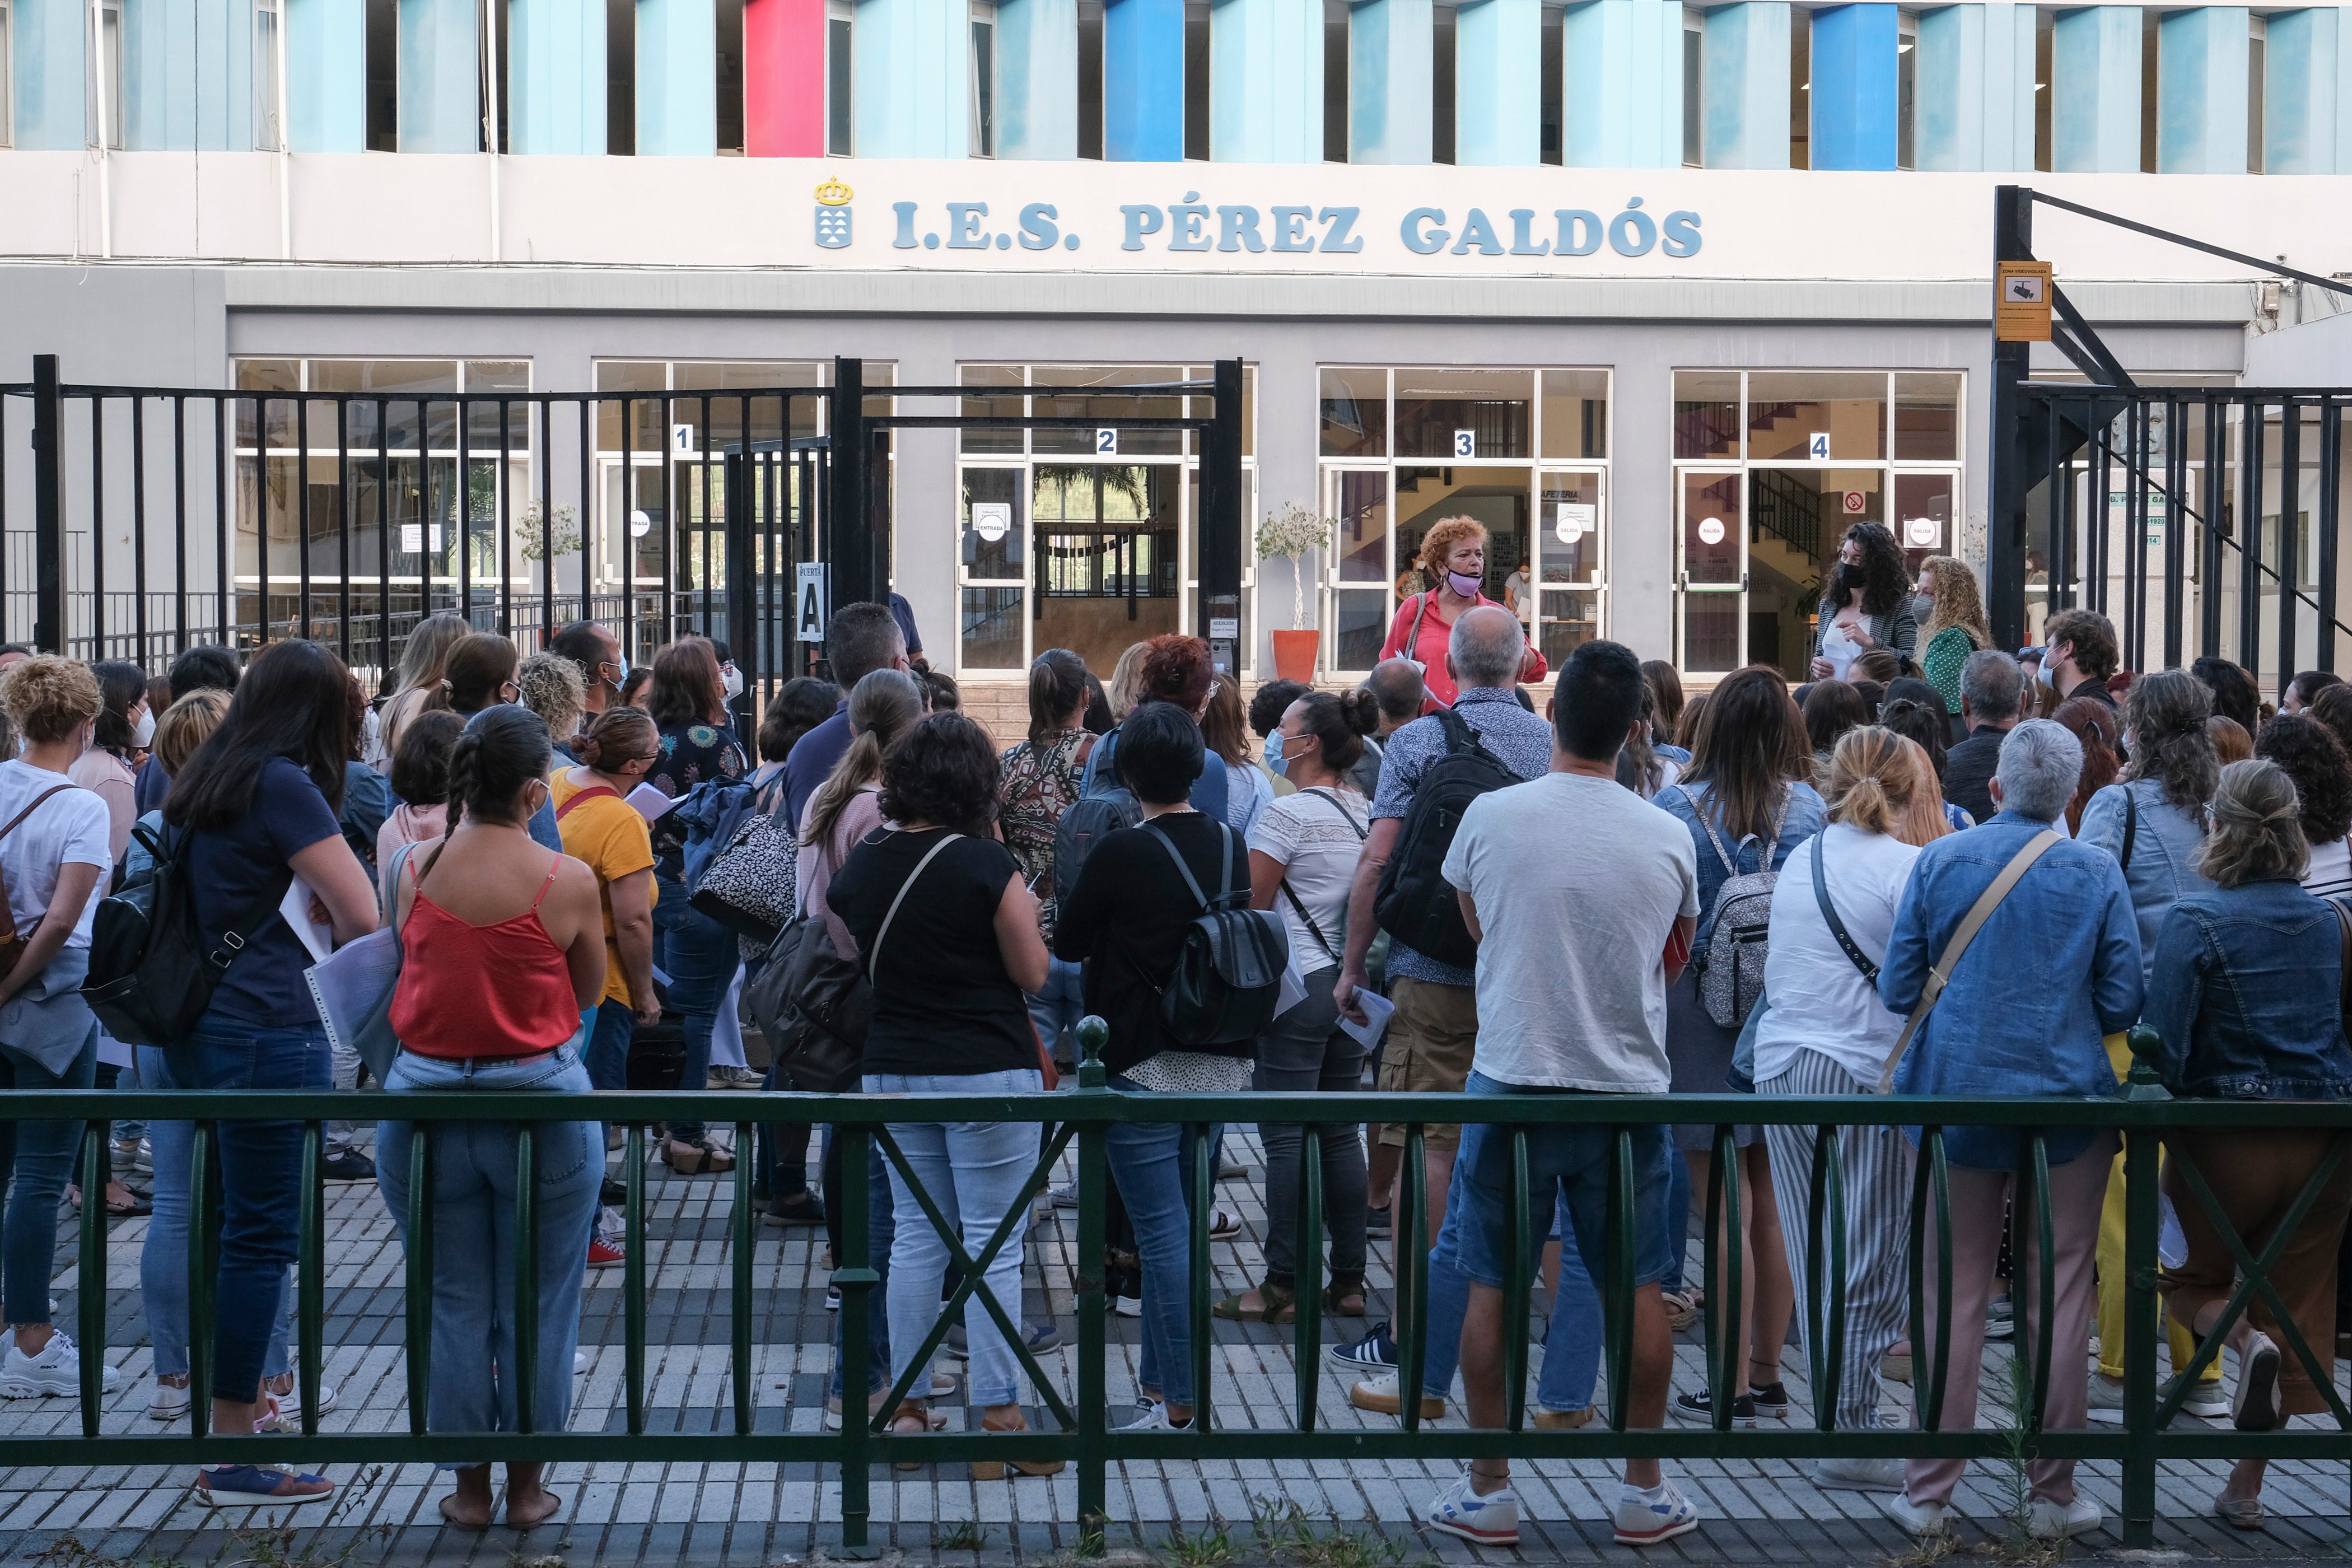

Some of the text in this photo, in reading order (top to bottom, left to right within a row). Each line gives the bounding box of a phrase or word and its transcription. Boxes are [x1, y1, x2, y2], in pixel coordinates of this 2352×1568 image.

[893, 191, 1702, 256] I.E.S. PÉREZ GALDÓS
[676, 428, 687, 449] 1
[1099, 431, 1114, 451] 2
[1457, 433, 1472, 456] 3
[1812, 436, 1828, 458] 4
[800, 568, 821, 576] PUERTA
[801, 583, 822, 633] A
